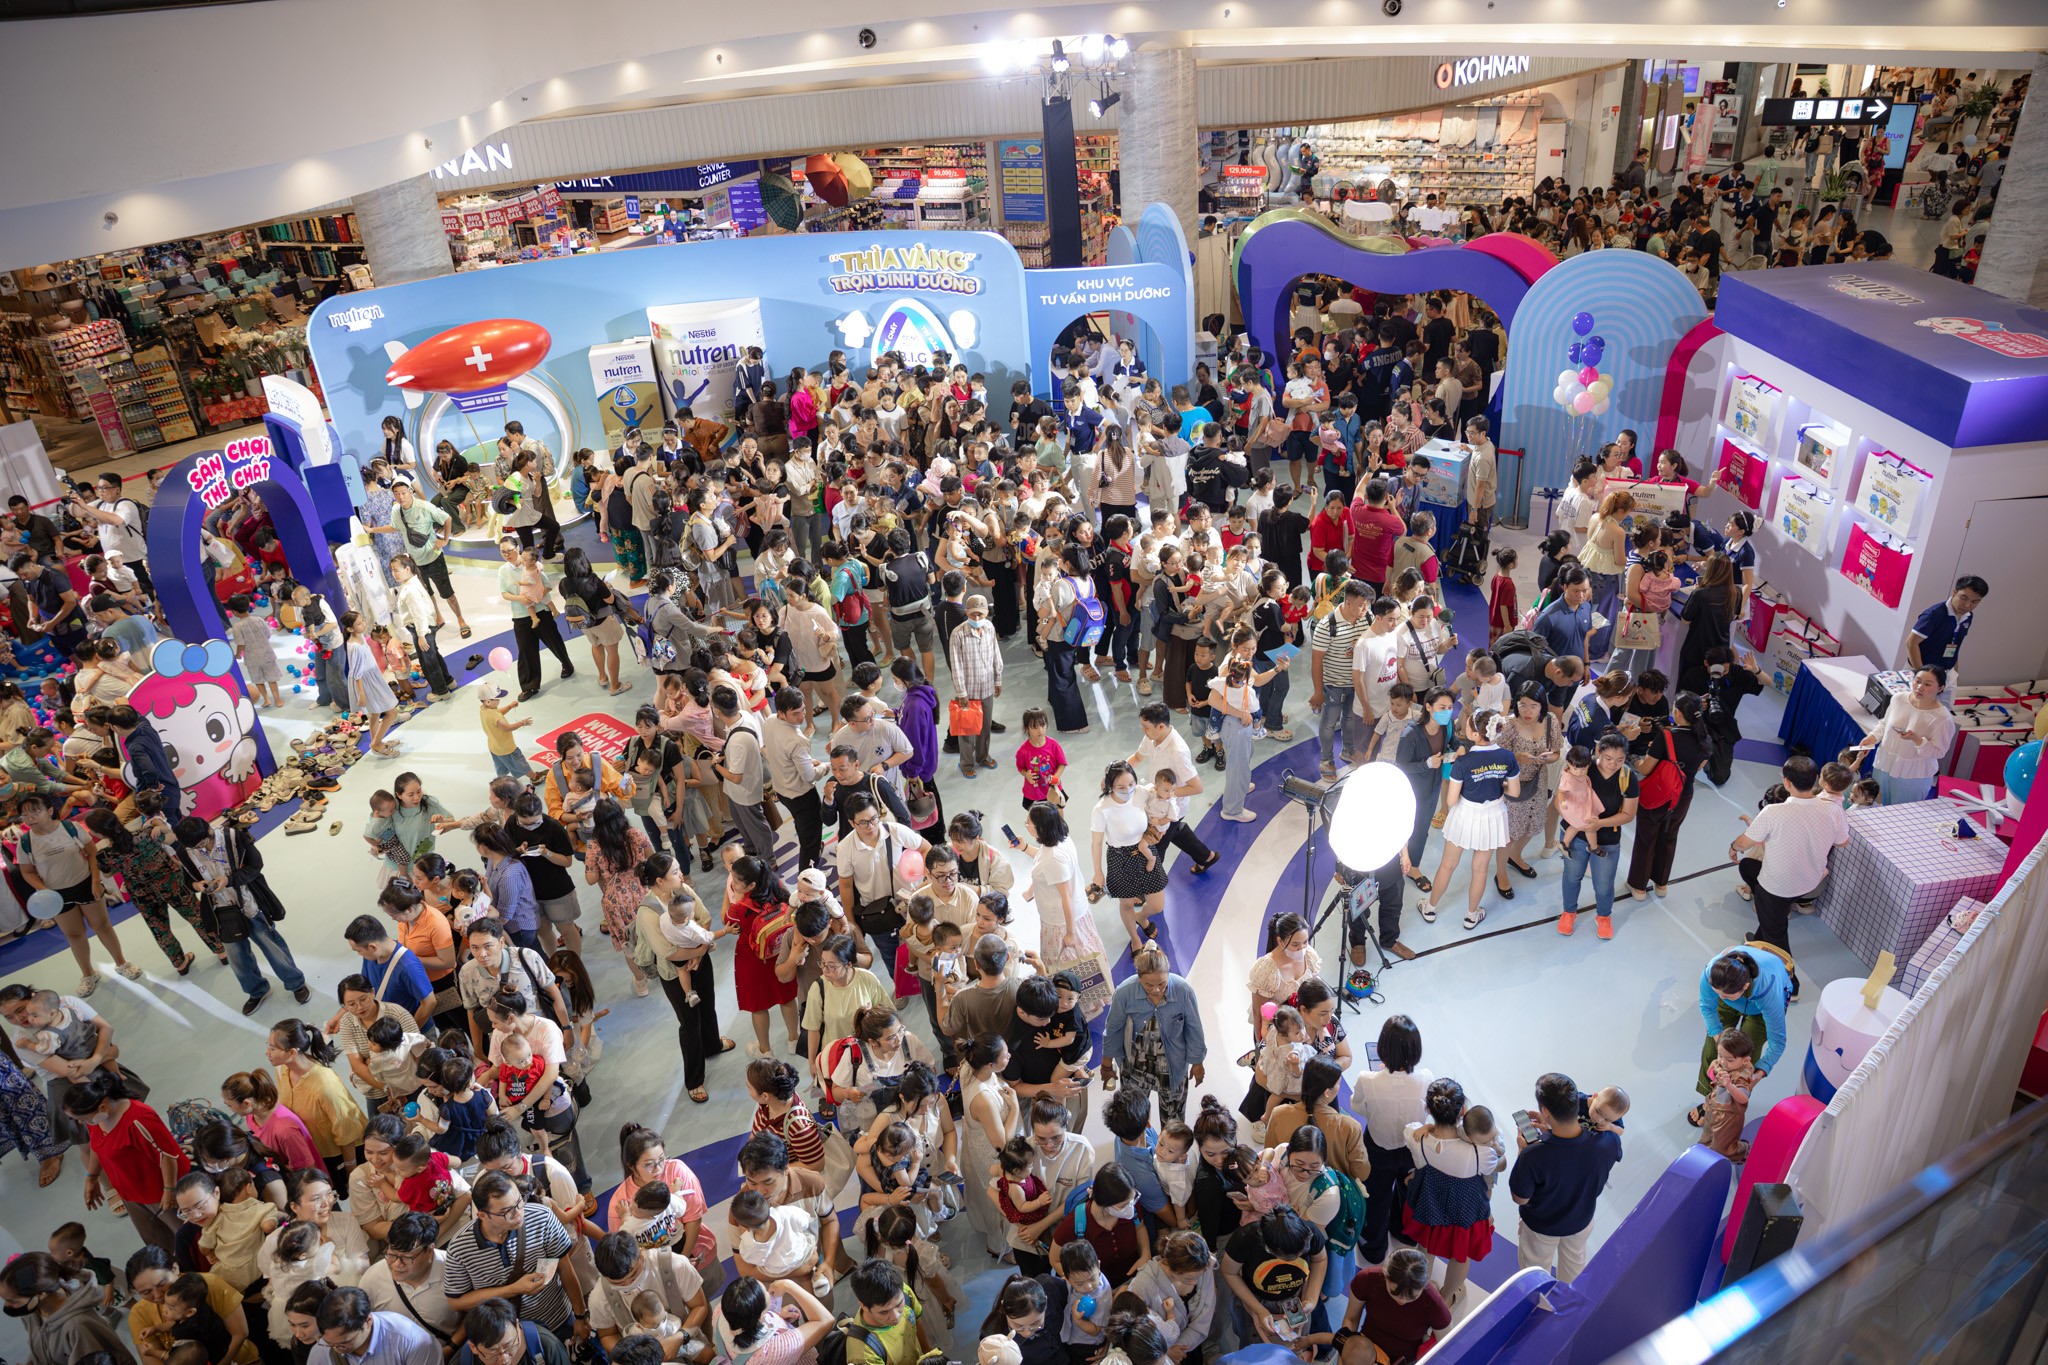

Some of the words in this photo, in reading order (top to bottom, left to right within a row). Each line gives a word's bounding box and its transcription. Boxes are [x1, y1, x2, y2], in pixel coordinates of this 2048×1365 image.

[1454, 56, 1529, 87] KOHNAN
[430, 143, 513, 179] NAN
[699, 169, 731, 187] COUNTER
[545, 191, 557, 199] BIG
[545, 197, 561, 206] SALE
[526, 199, 538, 207] BIG
[527, 205, 542, 214] SALE
[627, 202, 638, 213] 01
[507, 211, 522, 220] SALE
[830, 273, 875, 292] TRỌN
[877, 273, 915, 288] DINH
[917, 273, 977, 294] DƯỠNG
[1077, 280, 1104, 290] KHU
[1107, 276, 1134, 289] VỰC
[1040, 294, 1057, 305] TƯ
[1060, 292, 1086, 304] VẤN
[1090, 292, 1121, 303] DINH
[1125, 287, 1170, 301] DƯỠNG
[329, 305, 384, 328] nutren
[688, 328, 716, 339] Nestlé
[669, 344, 737, 365] nutren
[604, 365, 641, 377] nutren
[671, 366, 701, 376] Junior
[190, 455, 223, 490] SÂN
[227, 438, 269, 461] CHƠI
[203, 472, 229, 508] THỂ
[234, 456, 269, 487] CHẤT
[1632, 491, 1656, 499] nutren
[584, 719, 622, 740] NAM
